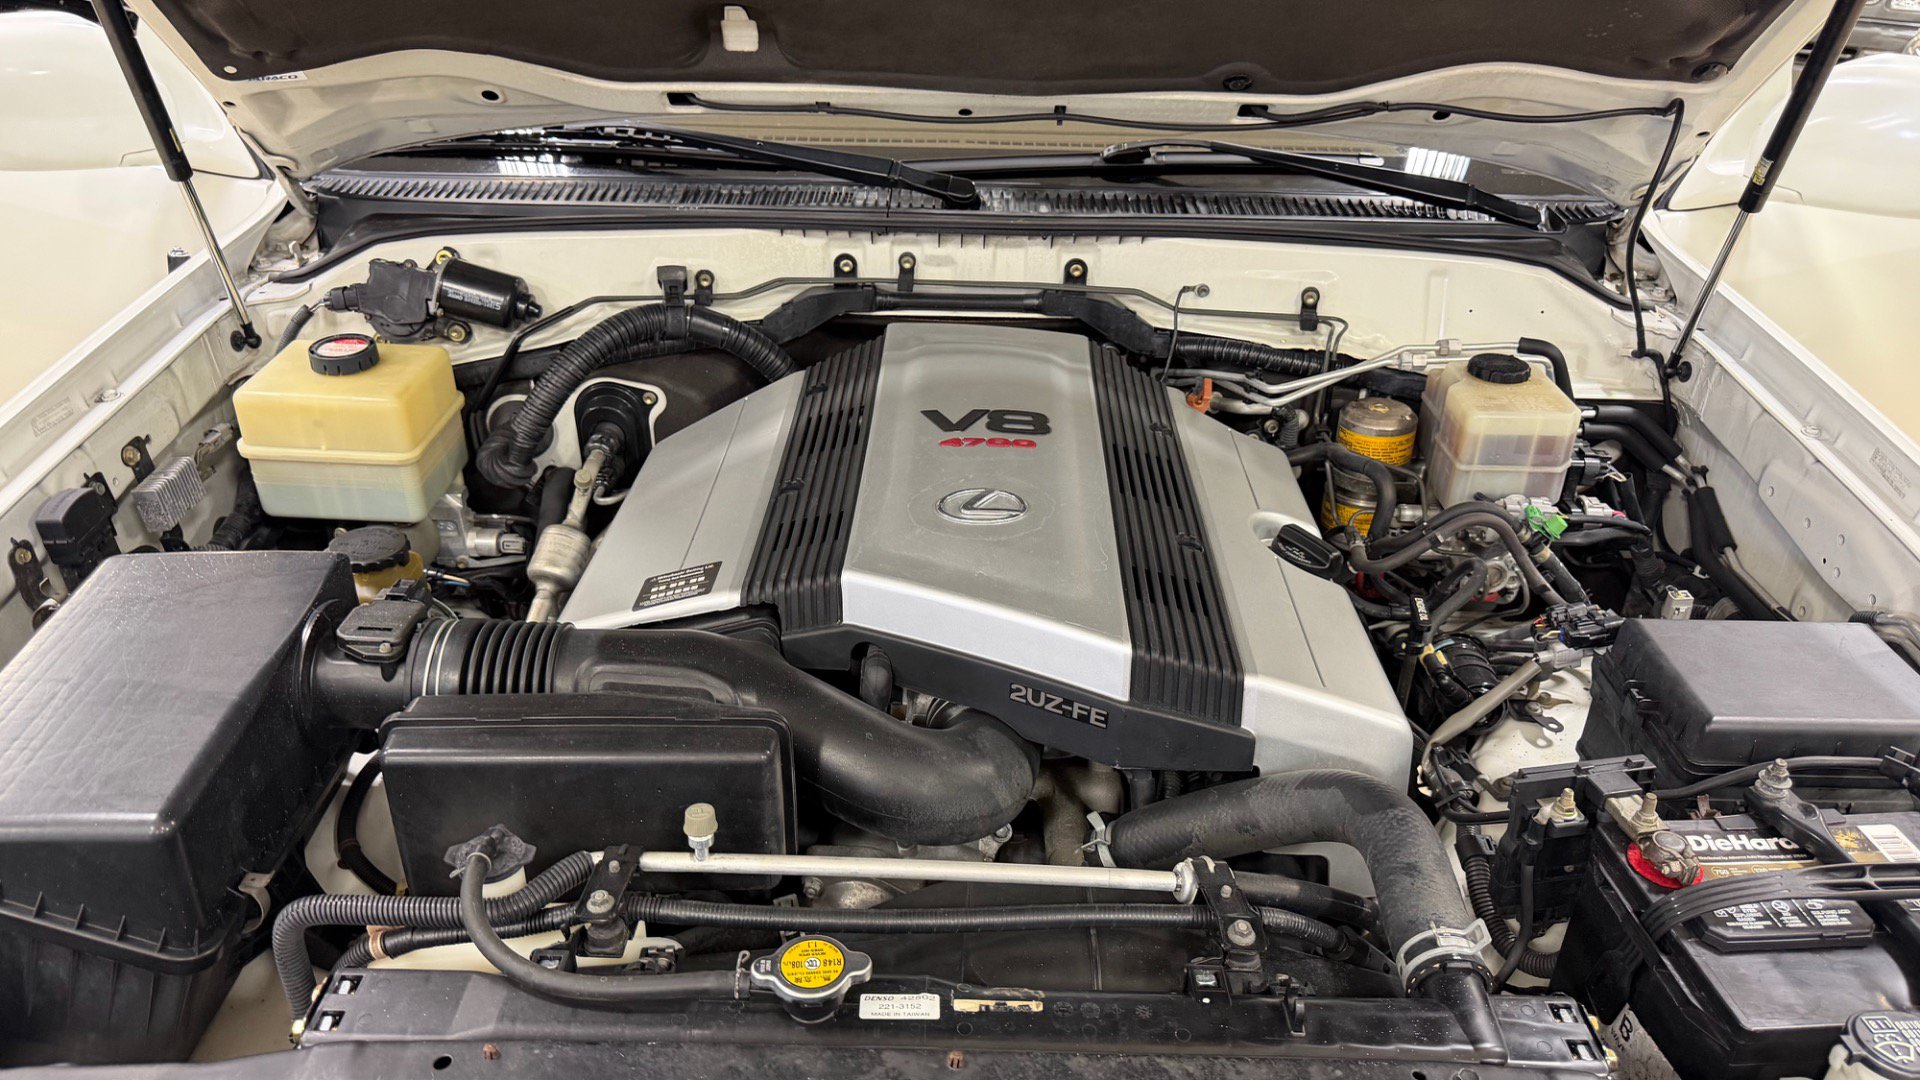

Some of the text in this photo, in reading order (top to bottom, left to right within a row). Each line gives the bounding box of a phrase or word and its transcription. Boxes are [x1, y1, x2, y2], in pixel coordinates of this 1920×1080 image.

[920, 409, 1052, 435] V8
[939, 437, 1037, 448] 4700
[1009, 683, 1108, 729] 2UZ-FE
